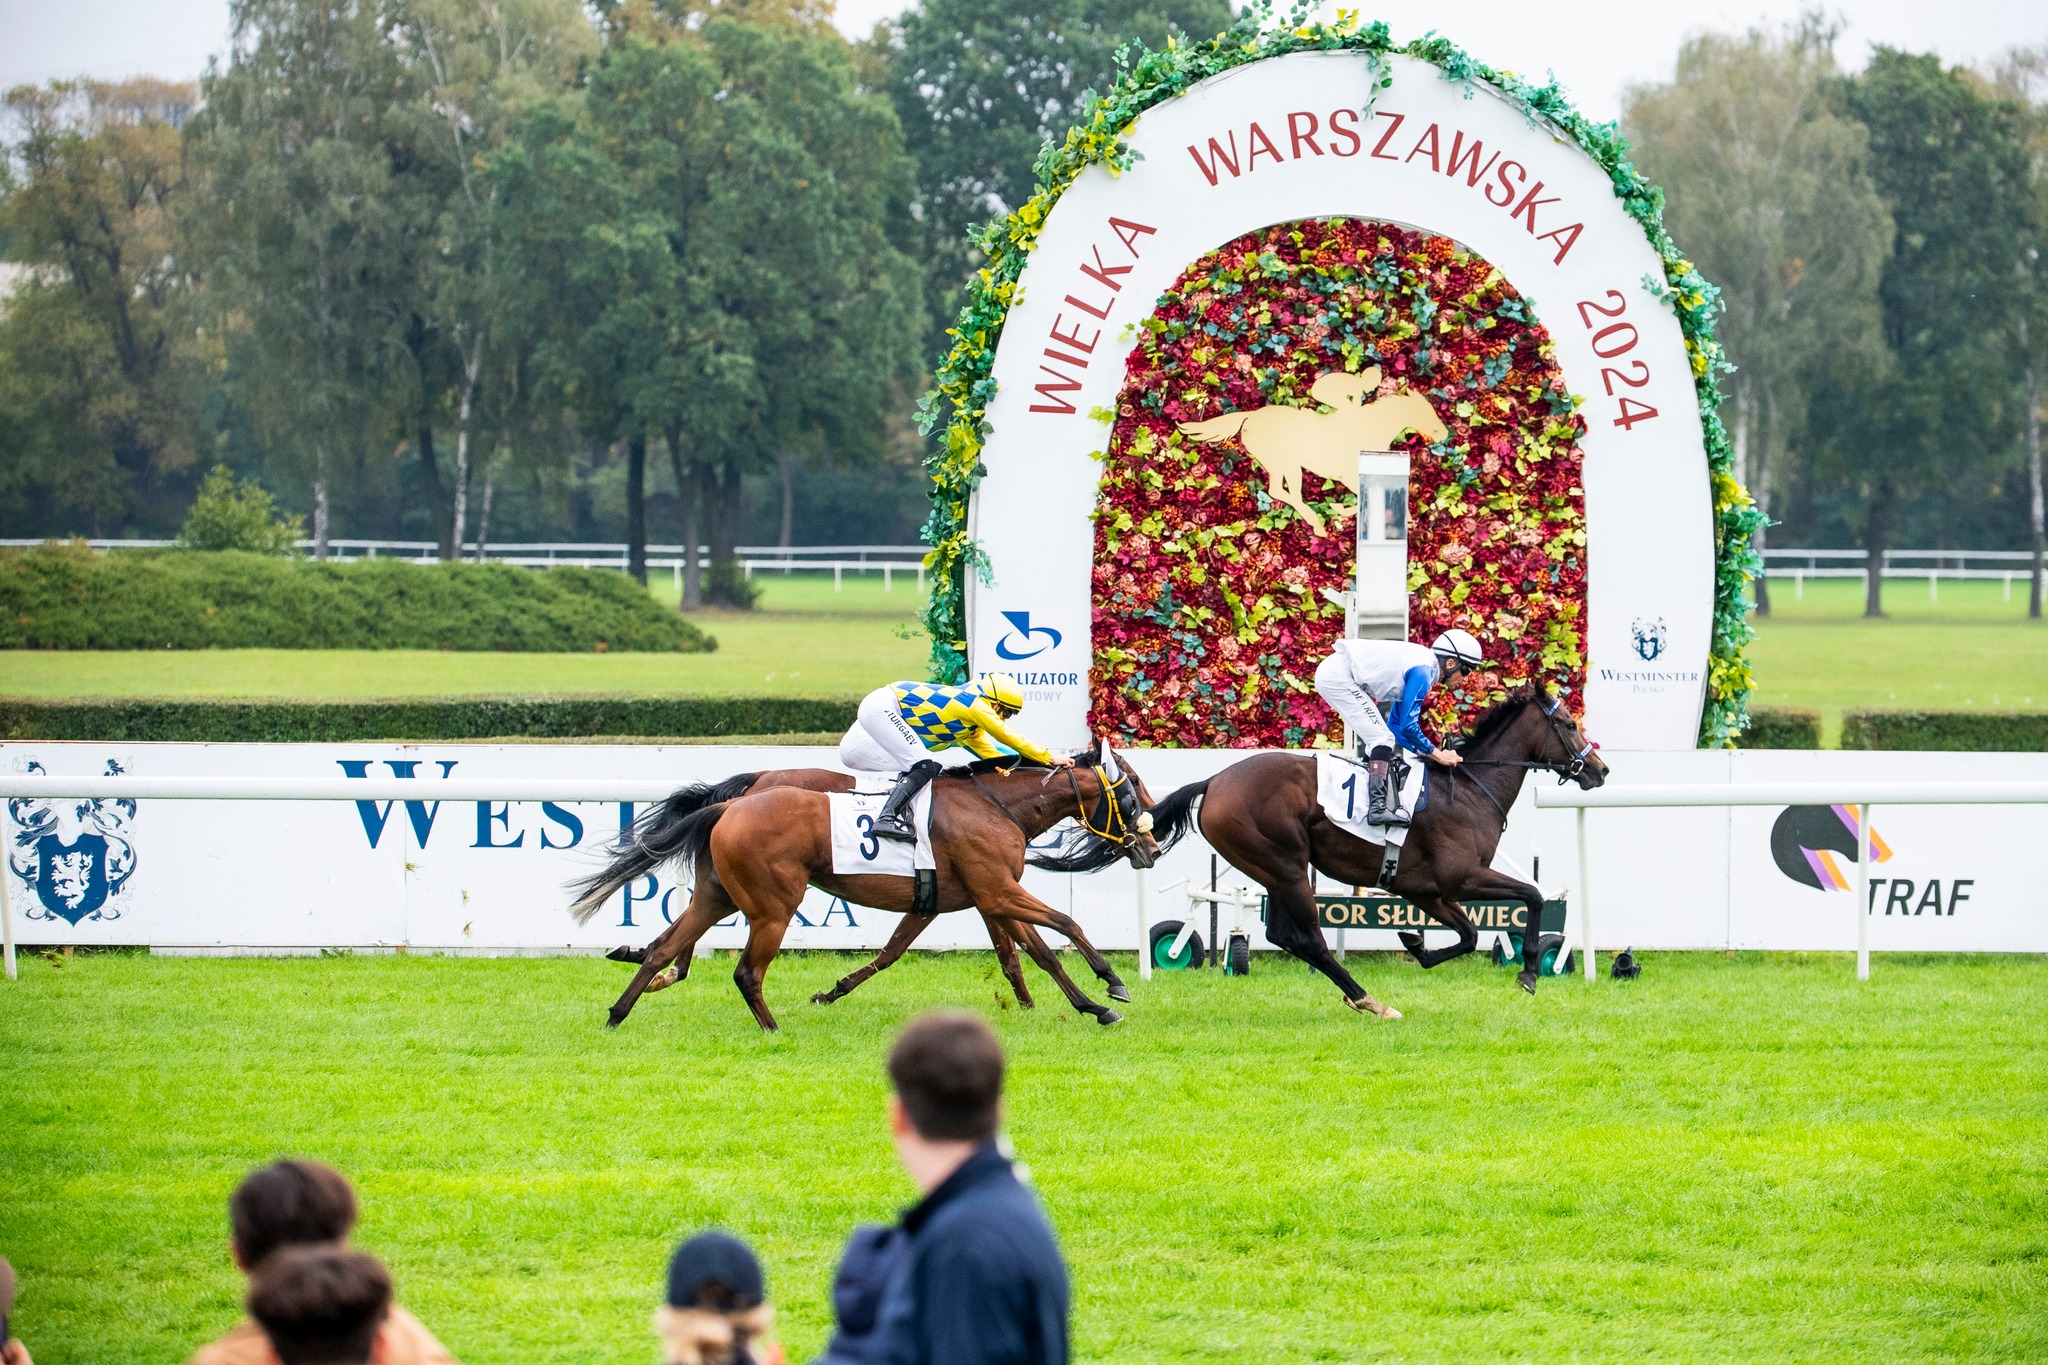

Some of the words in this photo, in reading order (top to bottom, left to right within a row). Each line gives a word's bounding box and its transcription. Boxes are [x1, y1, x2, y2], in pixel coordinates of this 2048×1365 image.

[1029, 215, 1157, 415] WIELKA
[1187, 109, 1586, 266] WARSZAWSKA
[1577, 289, 1660, 432] 2024
[1341, 773, 1356, 819] 1
[856, 813, 880, 861] 3
[1868, 878, 1975, 916] TRAF
